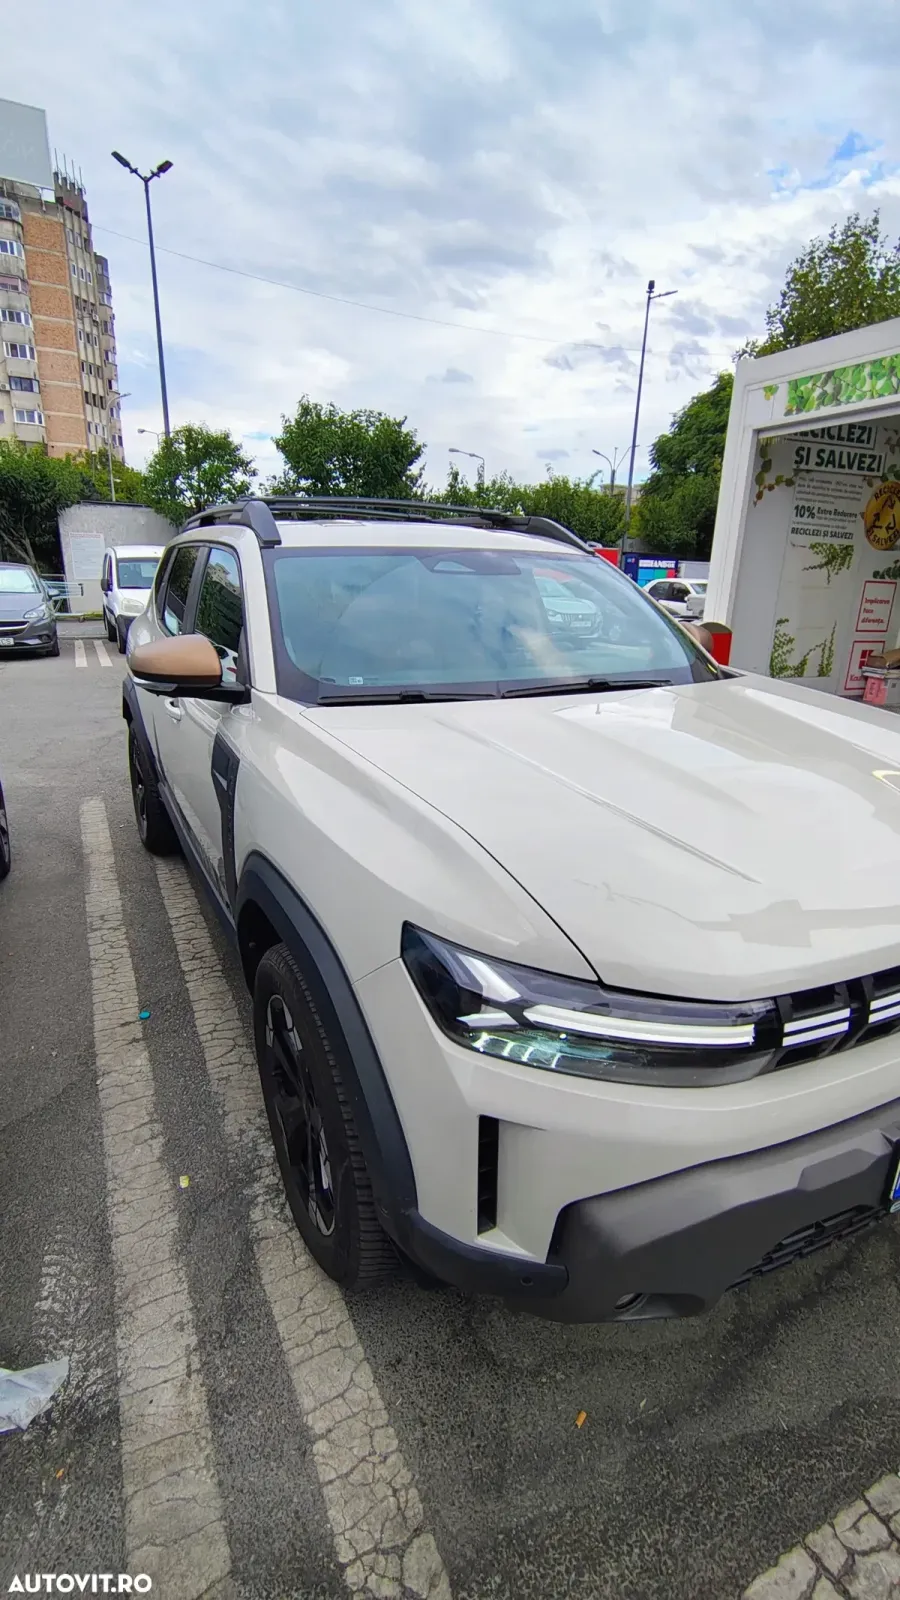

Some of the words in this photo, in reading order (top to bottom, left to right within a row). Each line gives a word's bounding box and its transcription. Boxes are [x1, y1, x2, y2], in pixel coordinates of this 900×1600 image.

[814, 448, 883, 473] SALVEZI
[794, 504, 816, 519] 10%
[791, 527, 822, 537] RECICLEZI
[829, 531, 854, 540] SALVEZI
